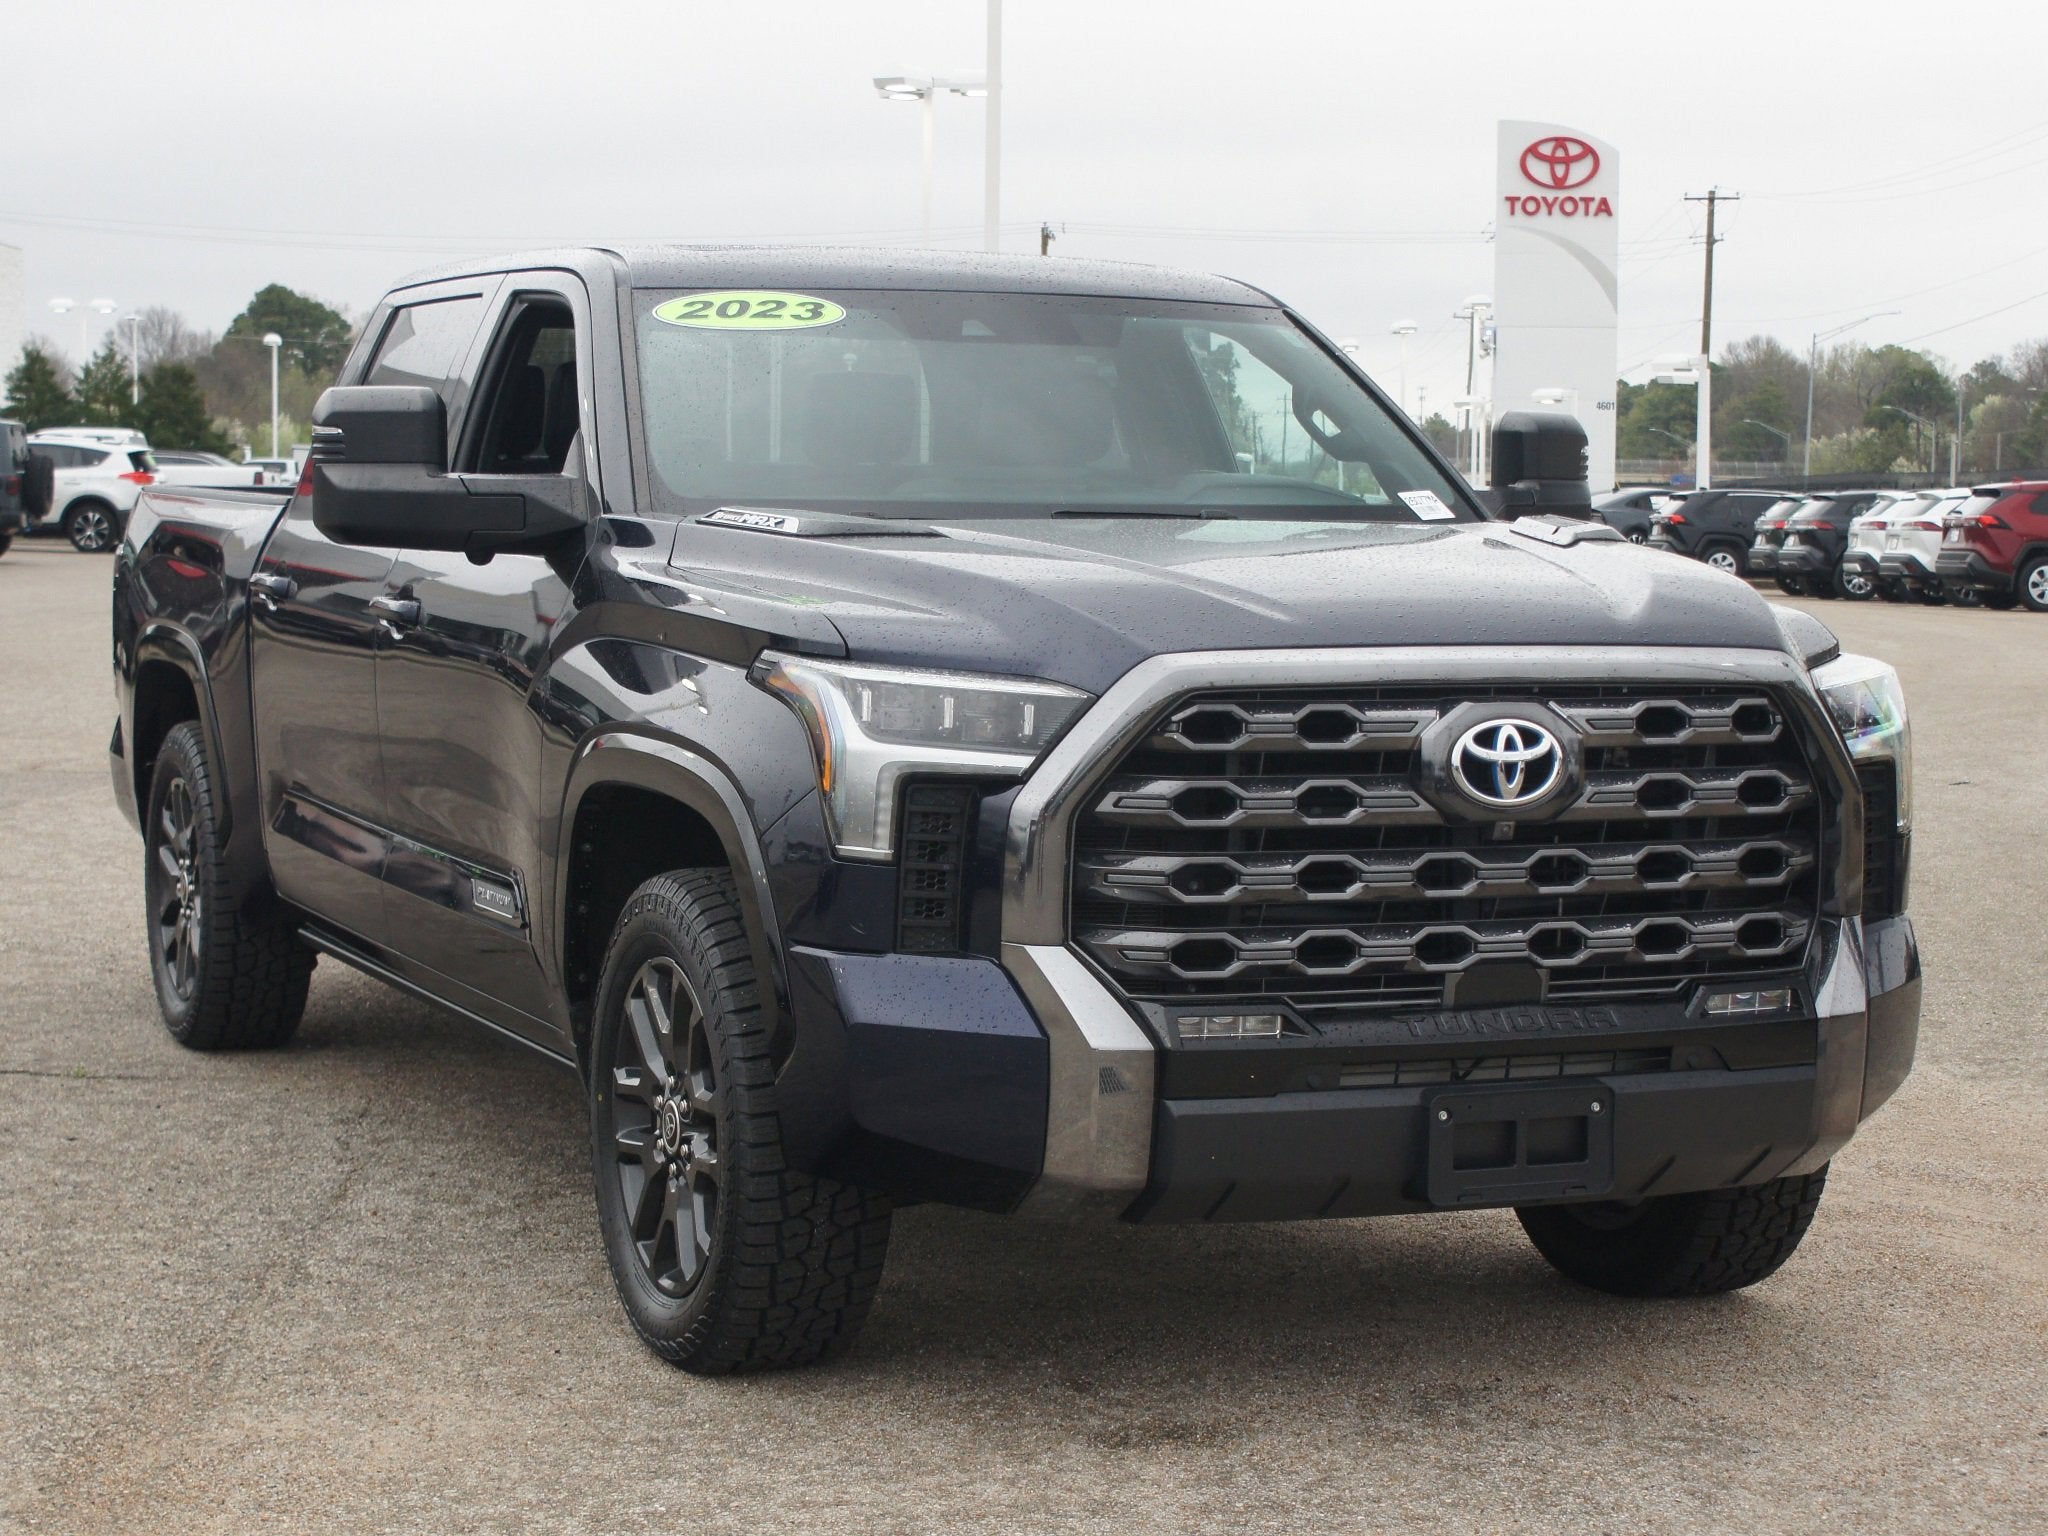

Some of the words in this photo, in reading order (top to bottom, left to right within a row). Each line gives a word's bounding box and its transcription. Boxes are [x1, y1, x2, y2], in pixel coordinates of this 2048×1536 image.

[1504, 195, 1613, 217] TOYOTA
[675, 299, 825, 321] 2023
[1596, 401, 1615, 411] 4601
[738, 513, 785, 528] MAX
[1393, 1009, 1621, 1037] TUNDRA
